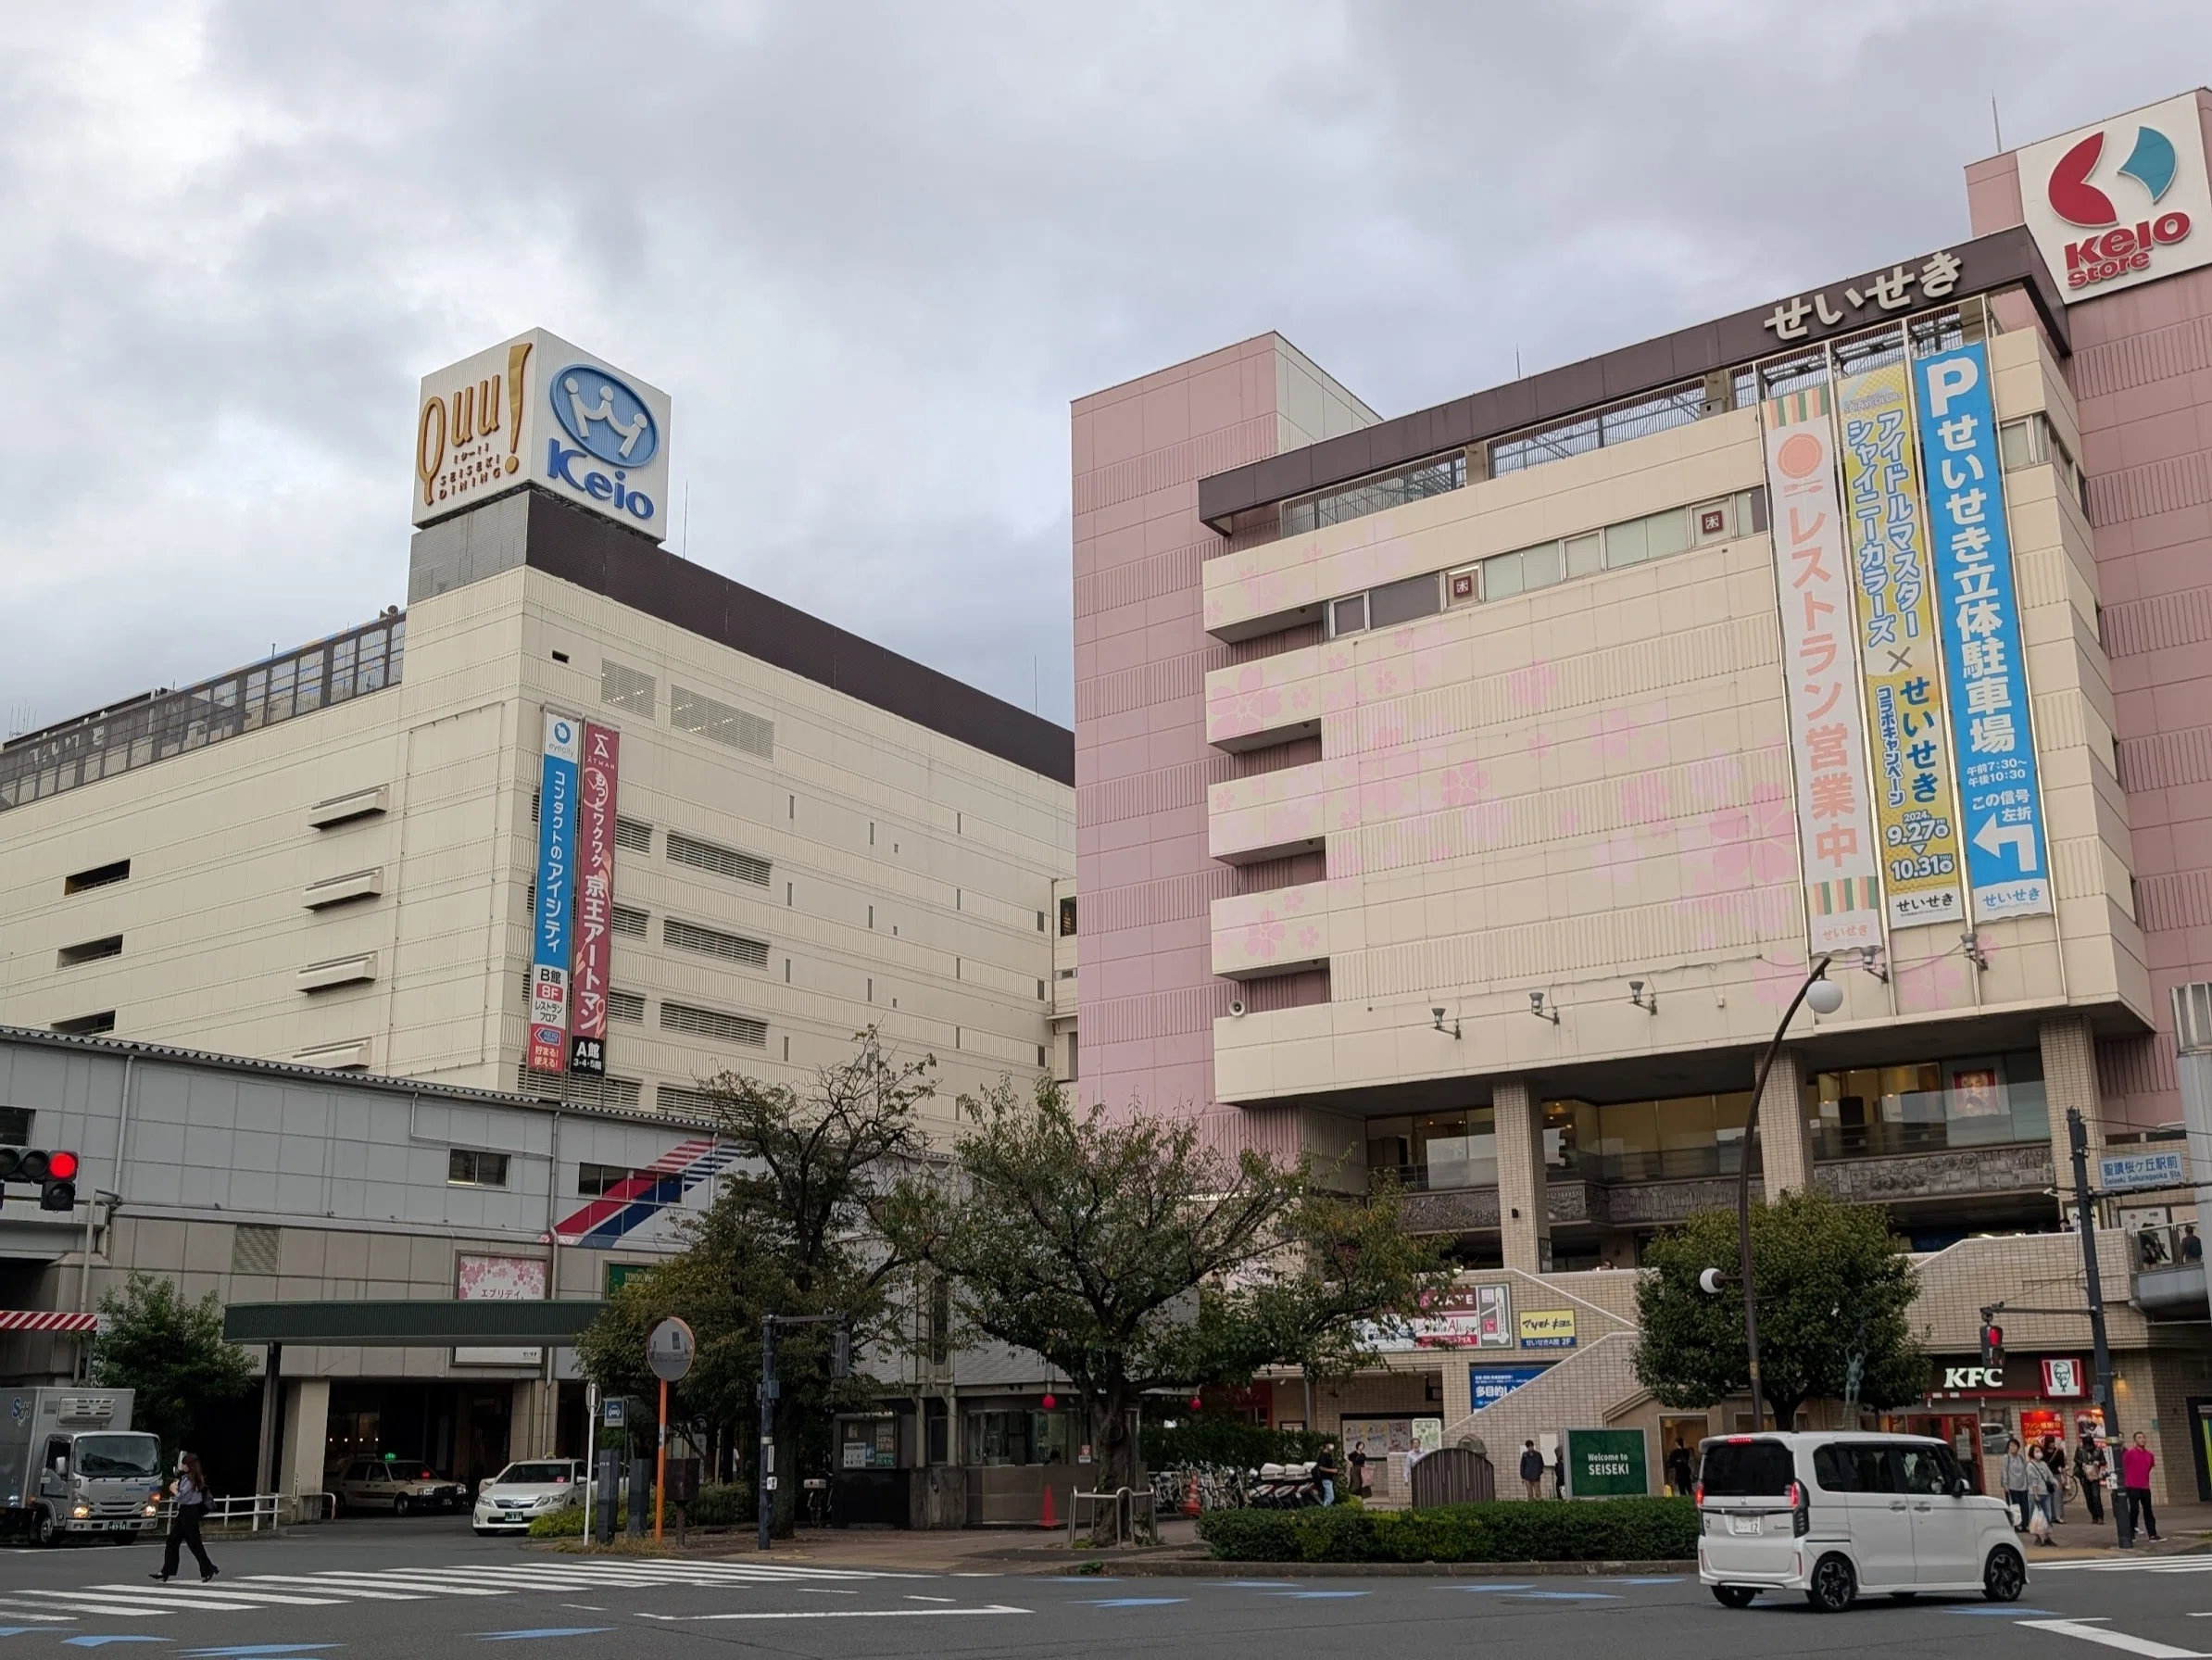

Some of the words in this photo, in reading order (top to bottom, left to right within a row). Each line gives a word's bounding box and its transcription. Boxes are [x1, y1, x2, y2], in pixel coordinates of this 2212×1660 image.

[1764, 252, 1963, 340] せいせき
[1927, 357, 1979, 418] P
[440, 454, 500, 486] SEISEKI
[547, 437, 655, 520] Keio
[439, 467, 501, 500] DINING
[1847, 420, 1896, 648] シャイニーカラーズ
[1877, 409, 1922, 638] アイドルマスター
[1937, 414, 2015, 754] せいせき立体駐車場
[1790, 507, 1858, 868] レストラン営業中
[548, 742, 575, 758] eyecity
[1876, 685, 1905, 809] コラボキャンペーン
[1900, 676, 1939, 803] せいせき
[1972, 789, 2030, 811] この信号
[2002, 806, 2032, 823] 左折
[1888, 820, 1935, 846] 9.27
[545, 771, 566, 953] コンタクトのアイシティ
[1891, 855, 1939, 881] 10.31
[1896, 892, 1954, 912] せいせき
[1982, 887, 2041, 907] せいせき
[580, 874, 605, 1030] 京王アートマン
[541, 986, 559, 999] 8F
[534, 1000, 563, 1014] レストラン
[539, 1012, 558, 1024] フロア
[576, 1041, 600, 1059] A館
[2128, 1172, 2168, 1183] Sakuragaoka
[1943, 1367, 2003, 1388] KFC
[1588, 1452, 1618, 1463] Welcome
[1621, 1452, 1628, 1461] to
[1589, 1463, 1629, 1476] SEISEKI
